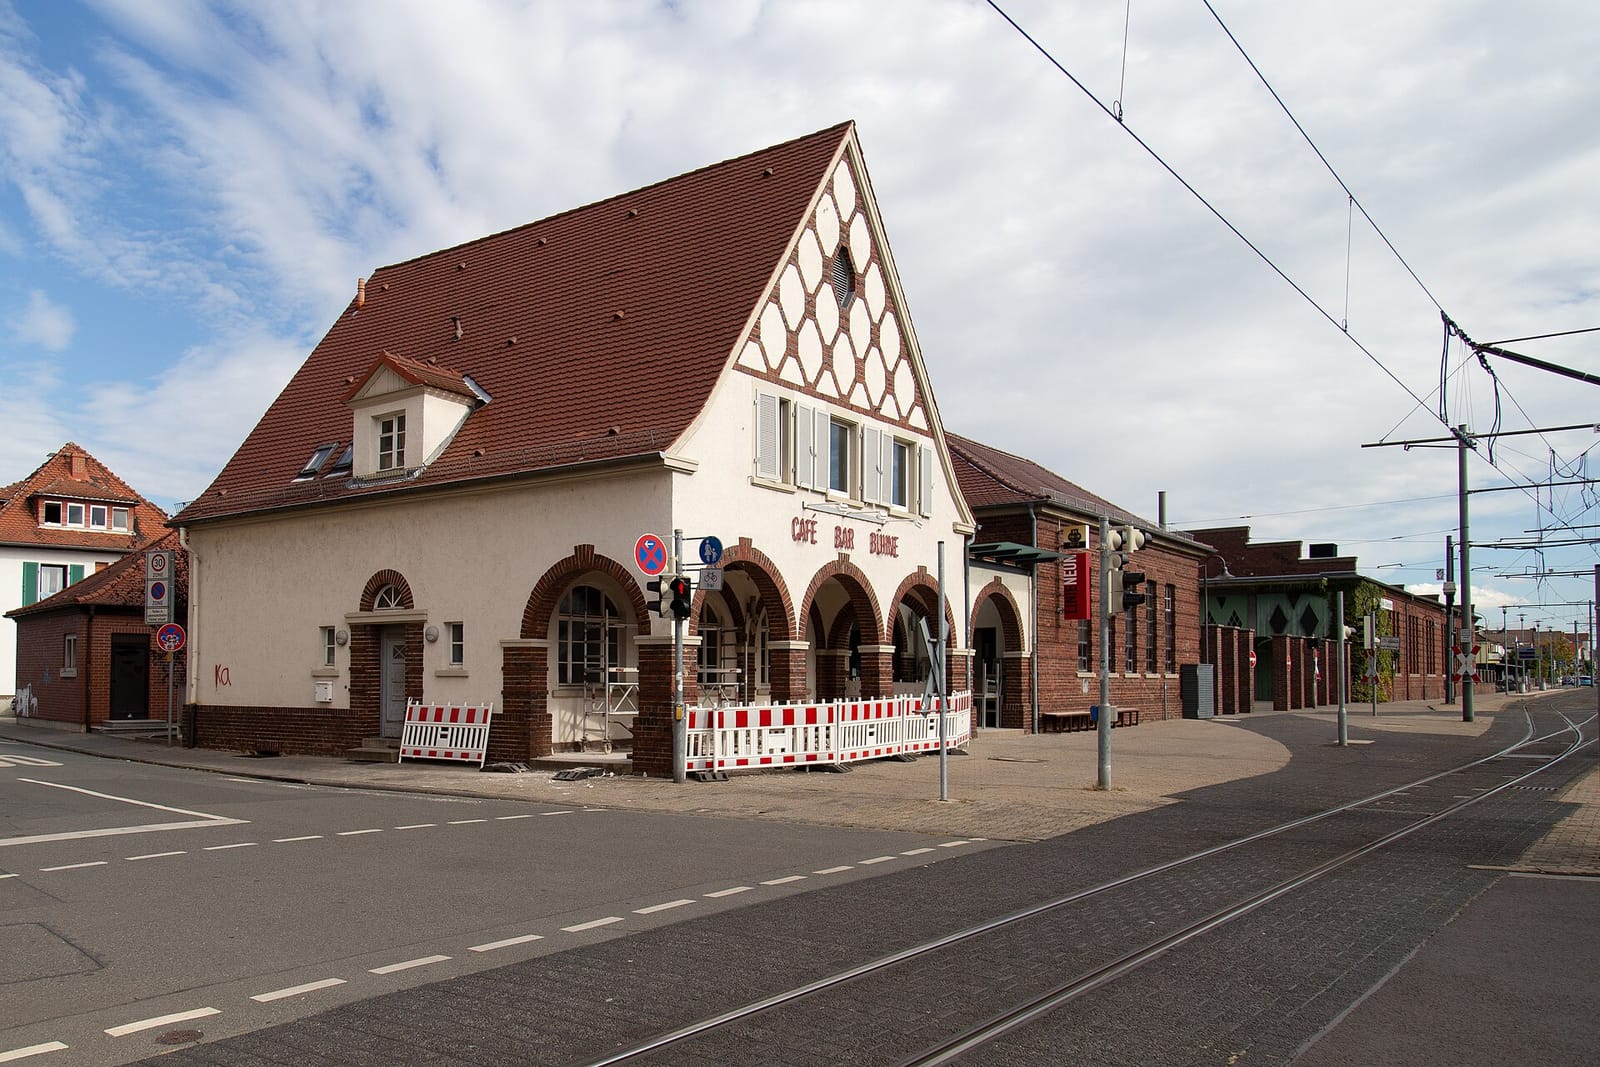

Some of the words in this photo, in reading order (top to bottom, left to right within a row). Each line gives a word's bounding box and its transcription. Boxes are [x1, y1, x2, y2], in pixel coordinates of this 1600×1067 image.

[791, 513, 818, 545] CAFÉ
[834, 525, 855, 550] BAR
[869, 528, 900, 558] BÜHNE
[154, 558, 163, 567] 30
